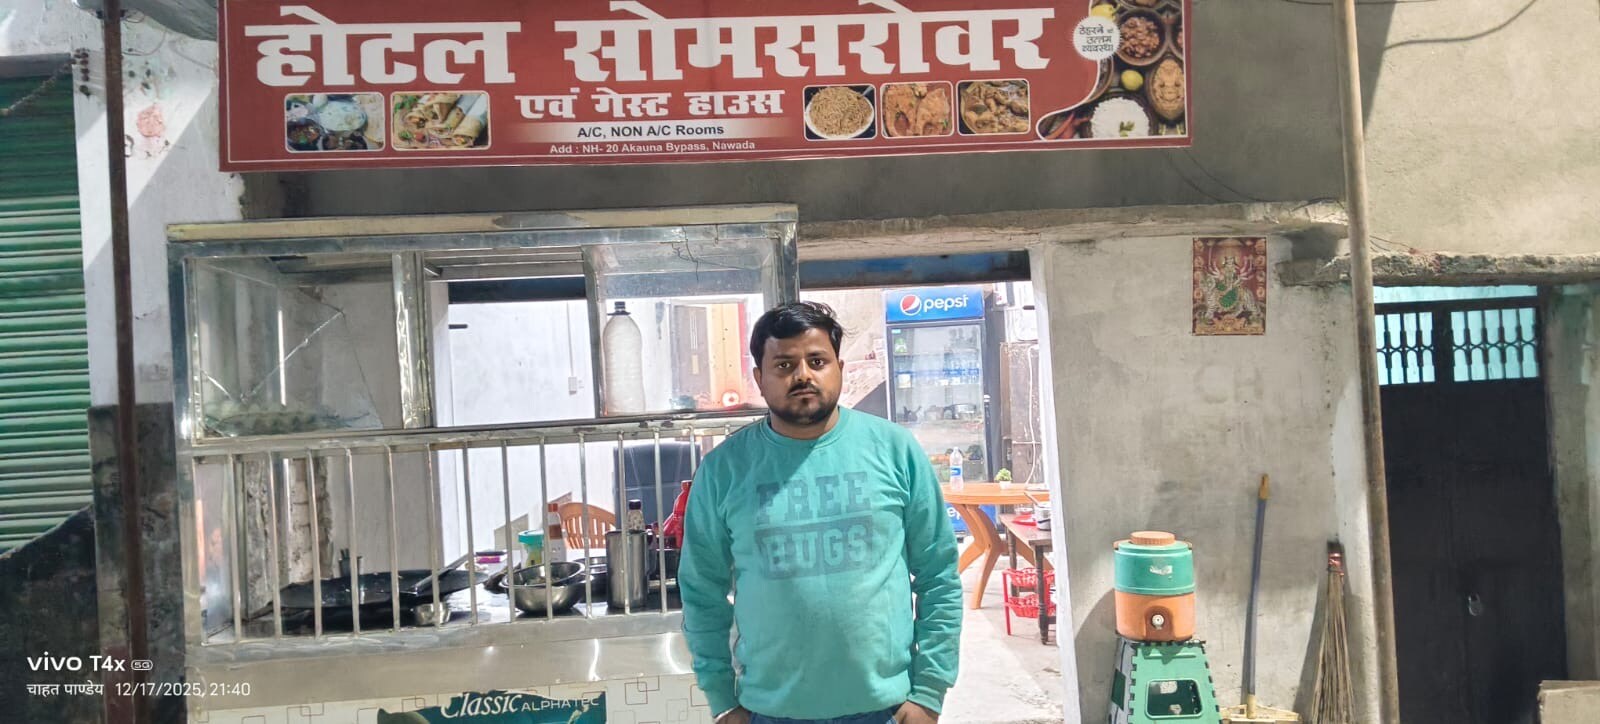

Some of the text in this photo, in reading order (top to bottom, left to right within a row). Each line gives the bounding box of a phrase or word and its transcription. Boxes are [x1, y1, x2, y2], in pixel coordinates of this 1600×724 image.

[244, 0, 1055, 87] होटल सोमसरोवर
[514, 87, 785, 119] एवं गेस्ट हाउस
[577, 124, 724, 139] A/C, NON A/C Rooms
[550, 144, 572, 154] Add
[582, 144, 603, 153] NH-
[606, 143, 619, 153] 20
[621, 142, 663, 152] Akauna
[666, 142, 709, 153] Bypass,
[712, 140, 755, 150] Nawada
[923, 293, 969, 313] pepsi
[756, 471, 872, 524] FREE
[441, 692, 522, 718] Classic
